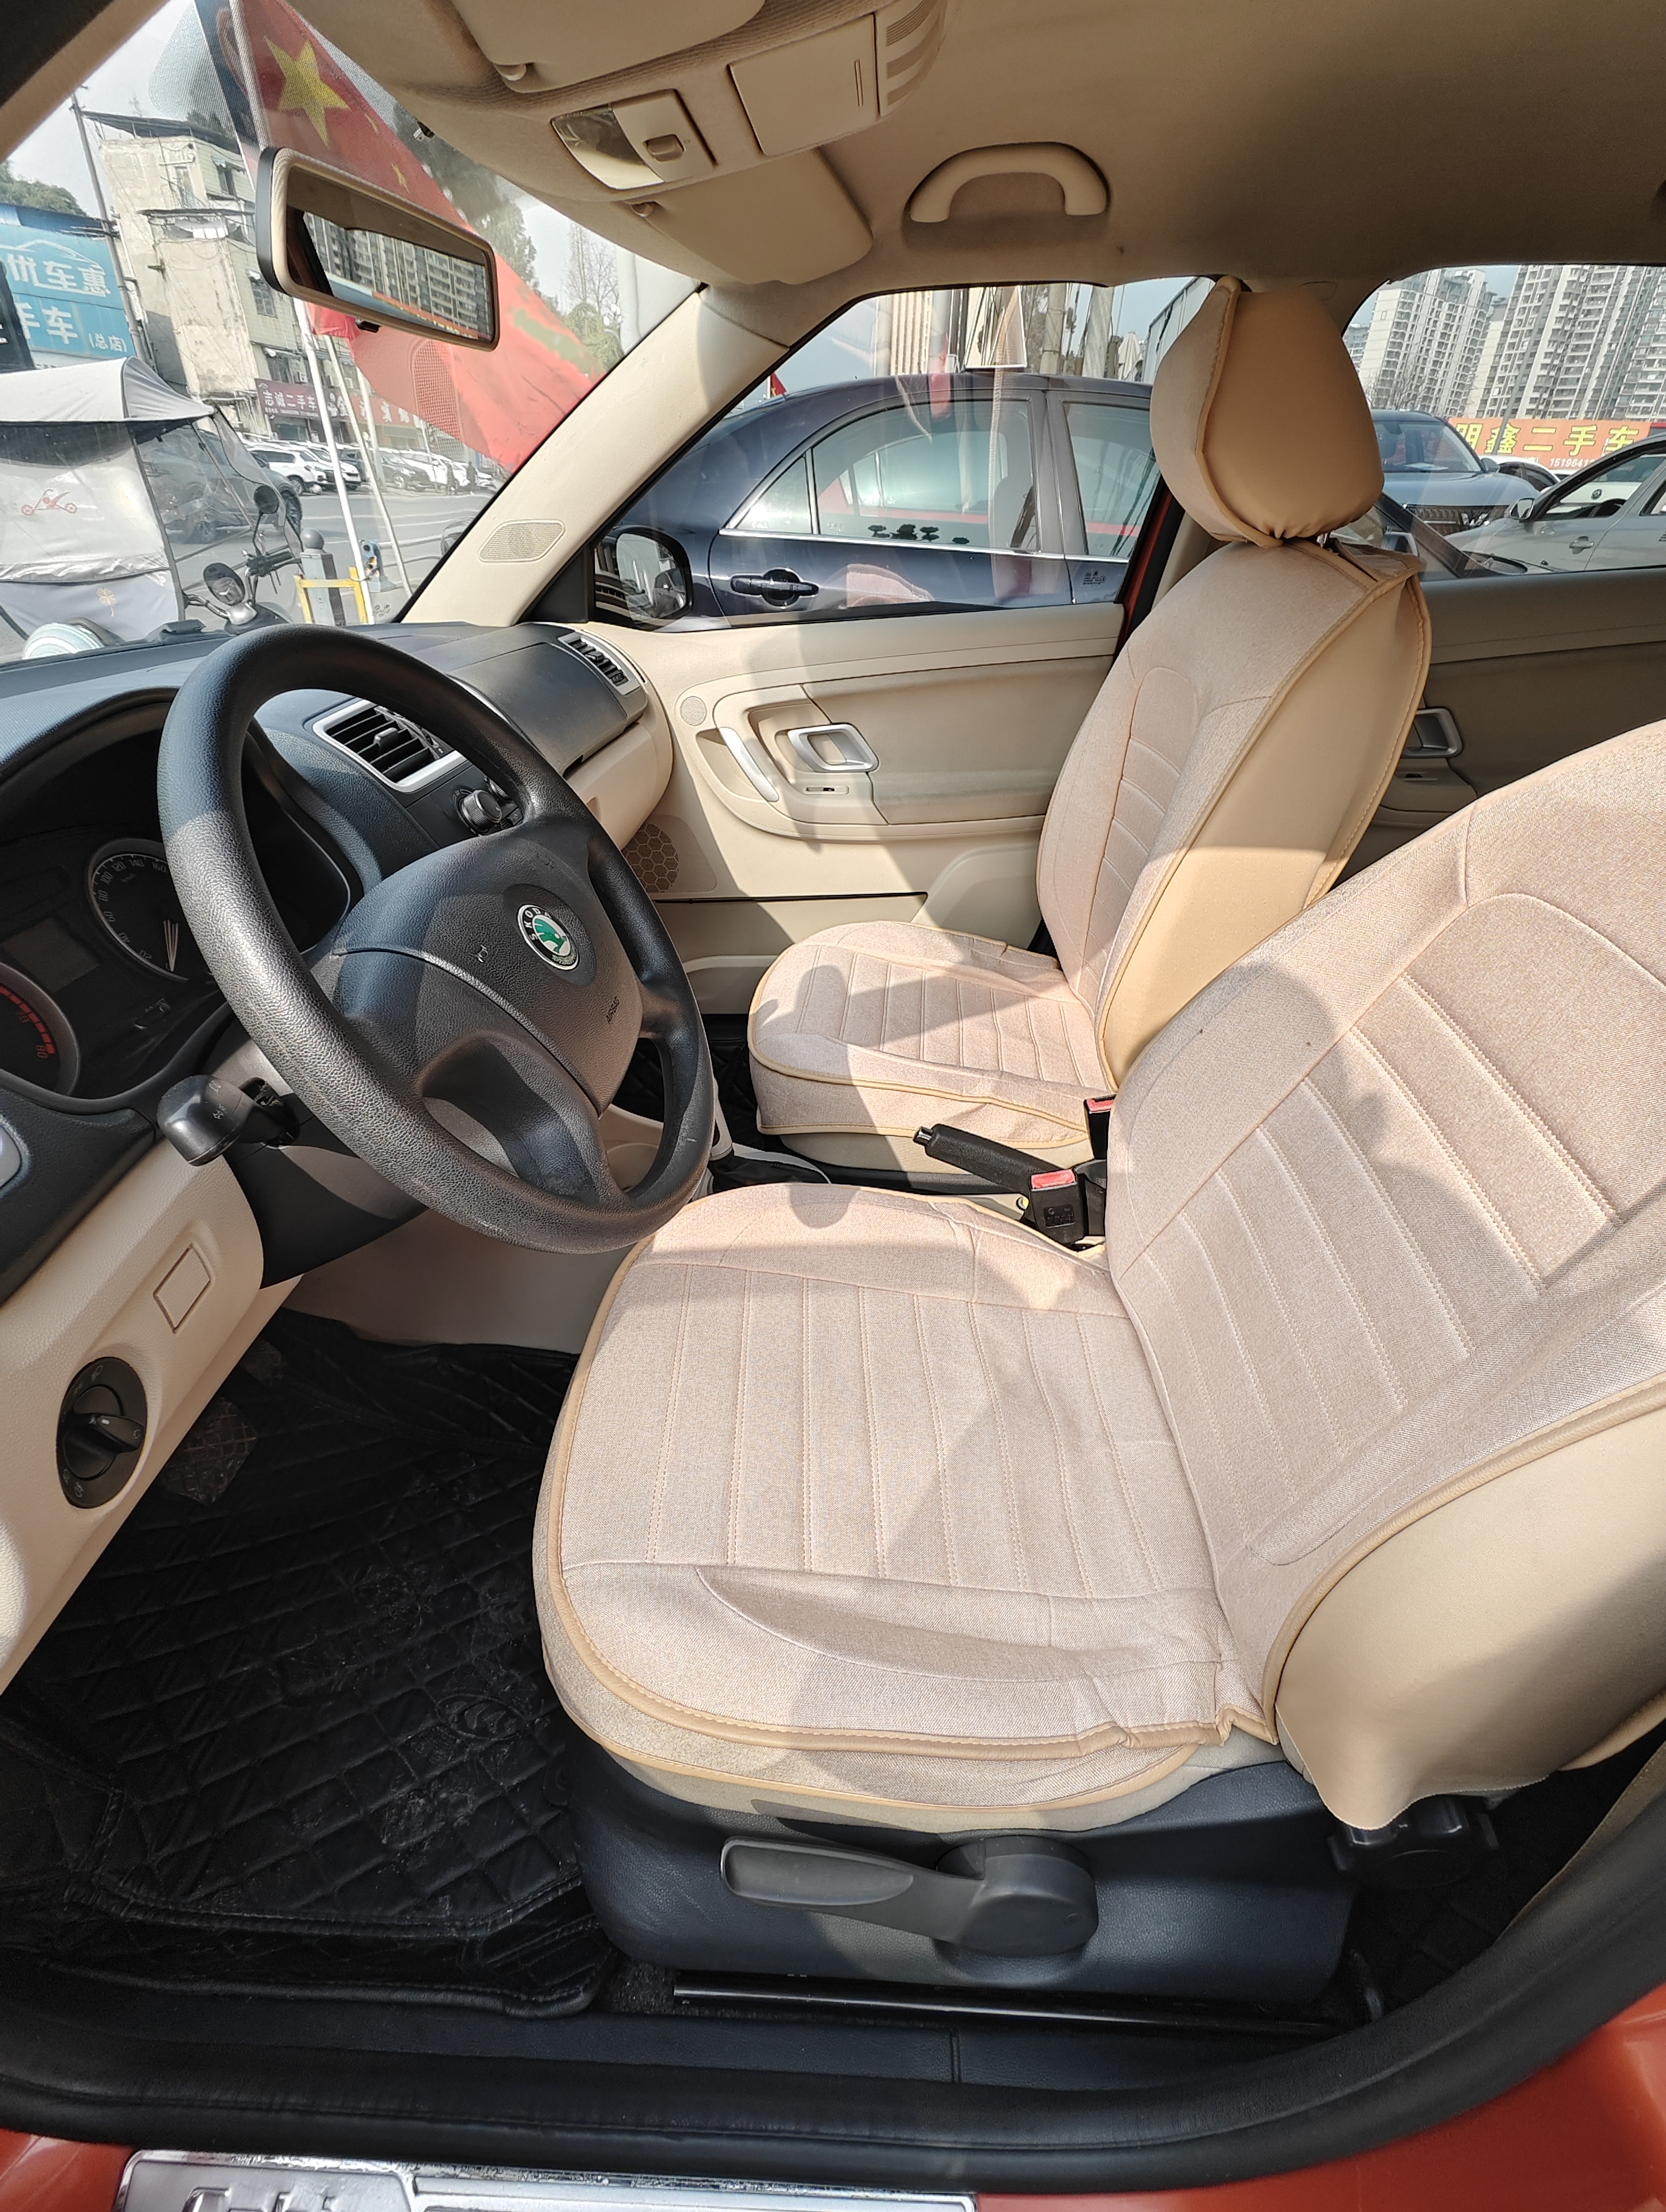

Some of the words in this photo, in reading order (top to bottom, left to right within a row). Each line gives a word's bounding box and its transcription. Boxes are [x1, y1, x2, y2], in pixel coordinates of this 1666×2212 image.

[1549, 458, 1595, 467] 1519641
[111, 861, 127, 872] 120
[128, 859, 145, 867] 140
[100, 871, 113, 884] 100
[98, 889, 108, 902] 80
[117, 931, 131, 943] 40
